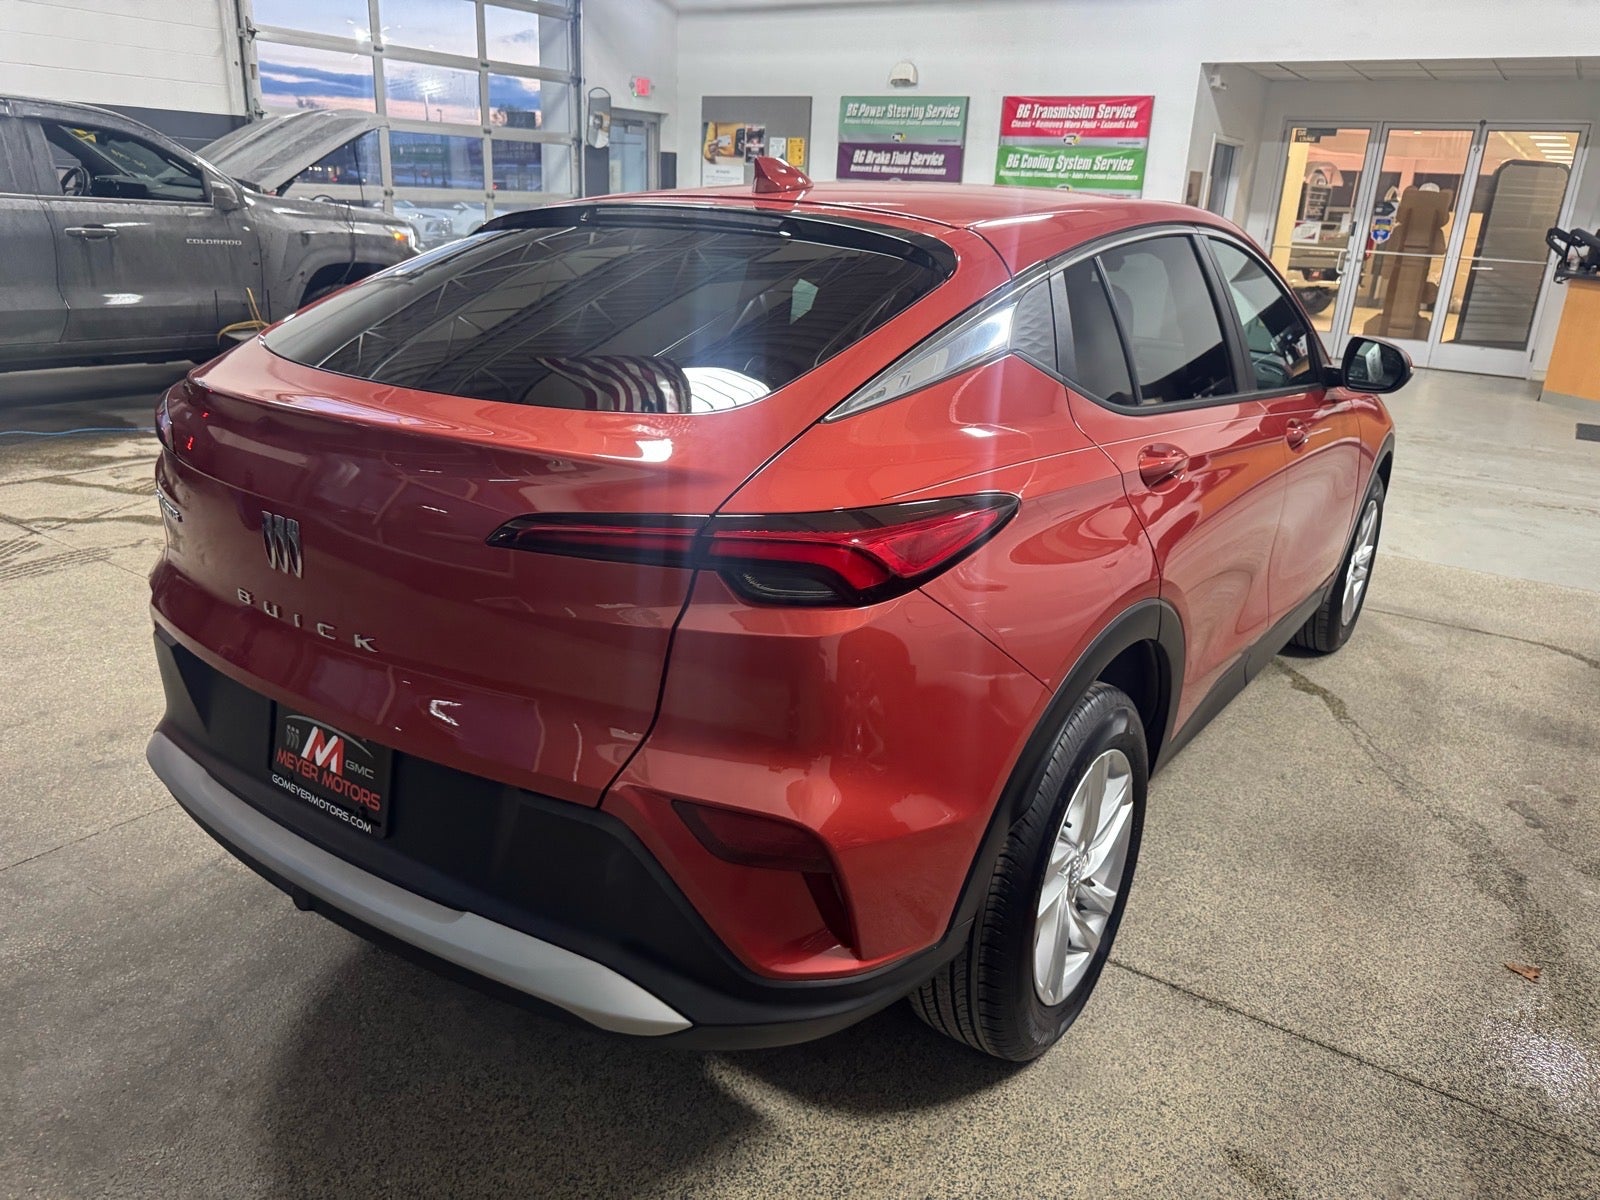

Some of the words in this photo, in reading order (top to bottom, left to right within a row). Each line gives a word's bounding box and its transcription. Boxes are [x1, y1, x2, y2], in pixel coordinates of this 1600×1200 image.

[846, 103, 859, 117] BG
[859, 103, 886, 117] Power
[887, 104, 925, 120] Steering
[925, 103, 960, 118] Service
[1016, 103, 1032, 119] BG
[1032, 103, 1094, 119] Transmission
[1096, 103, 1138, 119] Service
[1126, 120, 1139, 129] Life
[853, 149, 867, 163] BG
[865, 150, 891, 165] Brake
[890, 150, 912, 165] Fluid
[911, 151, 945, 166] Service
[1006, 153, 1019, 168] BG
[1020, 154, 1056, 172] Cooling
[1055, 155, 1093, 172] System
[1093, 156, 1134, 172] Service
[186, 238, 243, 246] COLORADO
[237, 587, 379, 653] BUICK
[345, 759, 375, 780] GMC
[276, 747, 319, 782] MEYER
[322, 770, 381, 812] MOTORS
[272, 774, 372, 834] GOMEYERMOTORS.COM
